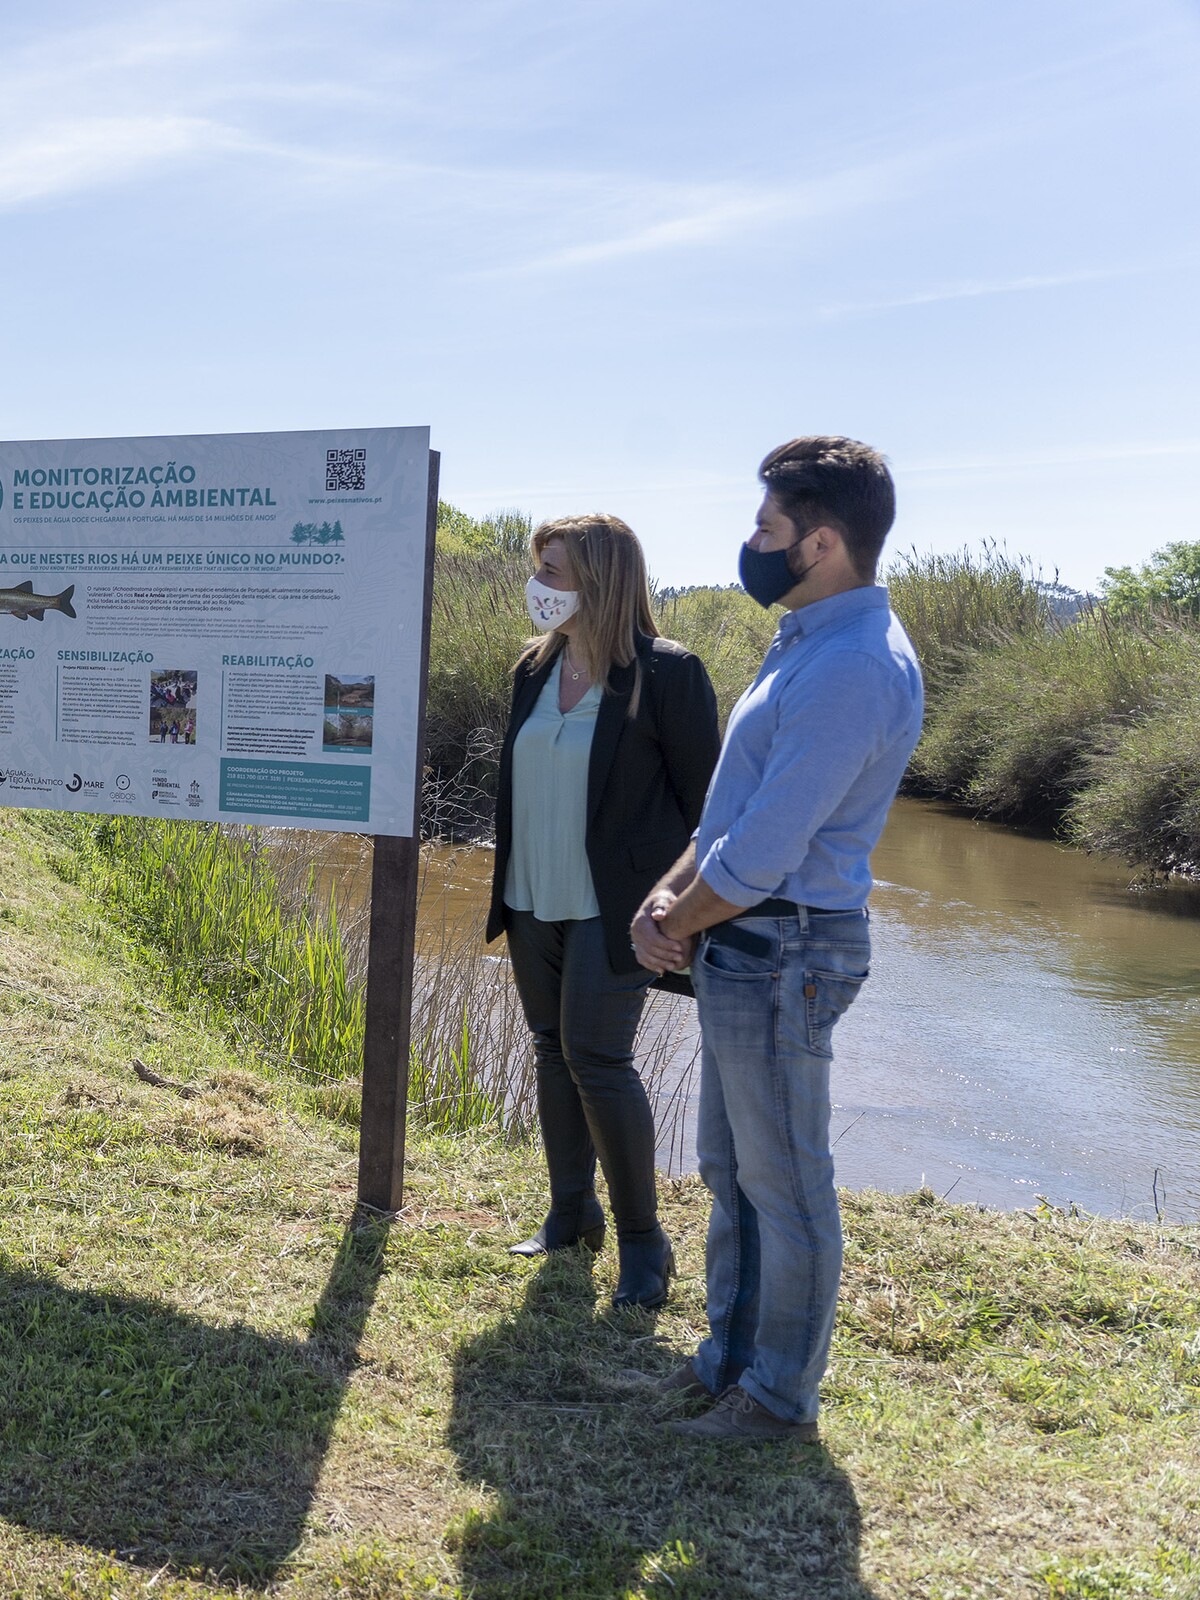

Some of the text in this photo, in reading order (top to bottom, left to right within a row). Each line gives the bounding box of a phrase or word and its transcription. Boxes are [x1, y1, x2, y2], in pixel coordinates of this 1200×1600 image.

[14, 461, 196, 490] MONITORIZAÇÃO
[13, 486, 277, 513] E EDUCAÇÃO AMBIENTAL
[307, 496, 382, 505] www.peixesnativos.pt
[52, 514, 70, 523] ÁGUA
[167, 513, 177, 522] HÁ
[213, 512, 244, 521] MILHÕES
[10, 553, 36, 566] QUE
[39, 553, 84, 564] NESTES
[87, 553, 117, 564] RIOS
[121, 551, 139, 564] HÁ
[142, 553, 162, 564] UM
[166, 553, 202, 564] PEIXE
[205, 551, 251, 564] ÚNICO
[254, 553, 275, 564] NO
[278, 553, 340, 564] MUNDO?
[56, 648, 154, 665] SENSIBILIZAÇÃO
[221, 652, 314, 670] REABILITAÇÃO
[4, 767, 26, 776] ÁGUAS
[226, 765, 268, 775] COORDENAÇÃO
[8, 775, 64, 786] TEJO ATLÂNTICO
[83, 780, 105, 789] MARE
